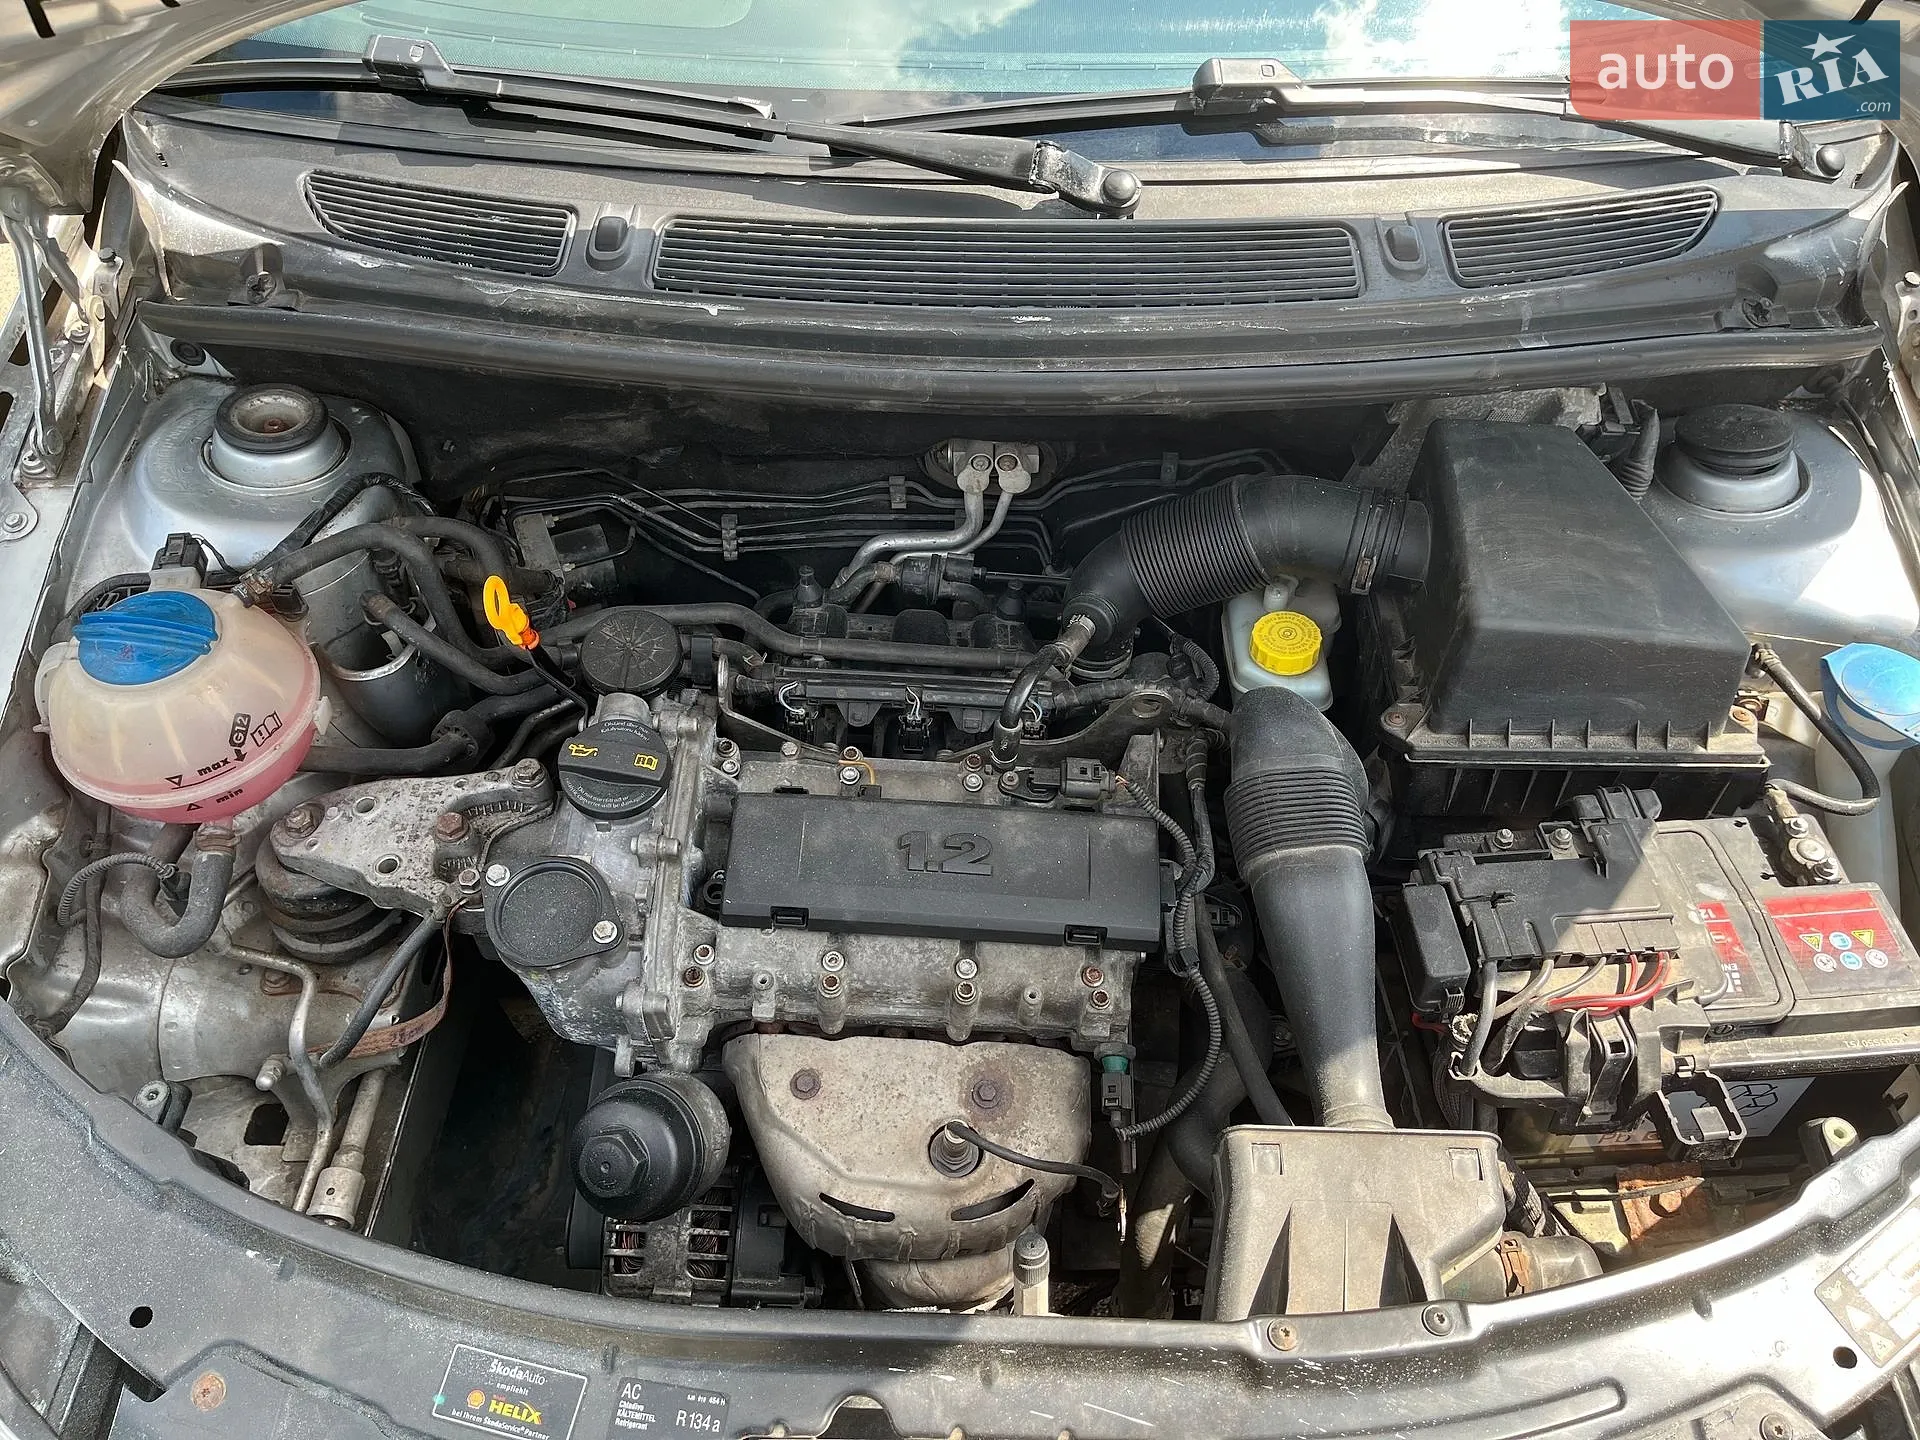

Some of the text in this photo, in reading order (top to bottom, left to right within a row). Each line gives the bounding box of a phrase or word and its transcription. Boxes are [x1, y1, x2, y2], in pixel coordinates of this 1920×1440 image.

[232, 716, 249, 744] G12
[197, 758, 231, 776] max
[216, 788, 243, 803] min
[898, 831, 993, 876] 1.2
[621, 1383, 642, 1400] AC
[451, 1408, 462, 1418] bei
[489, 1399, 542, 1424] HELIX
